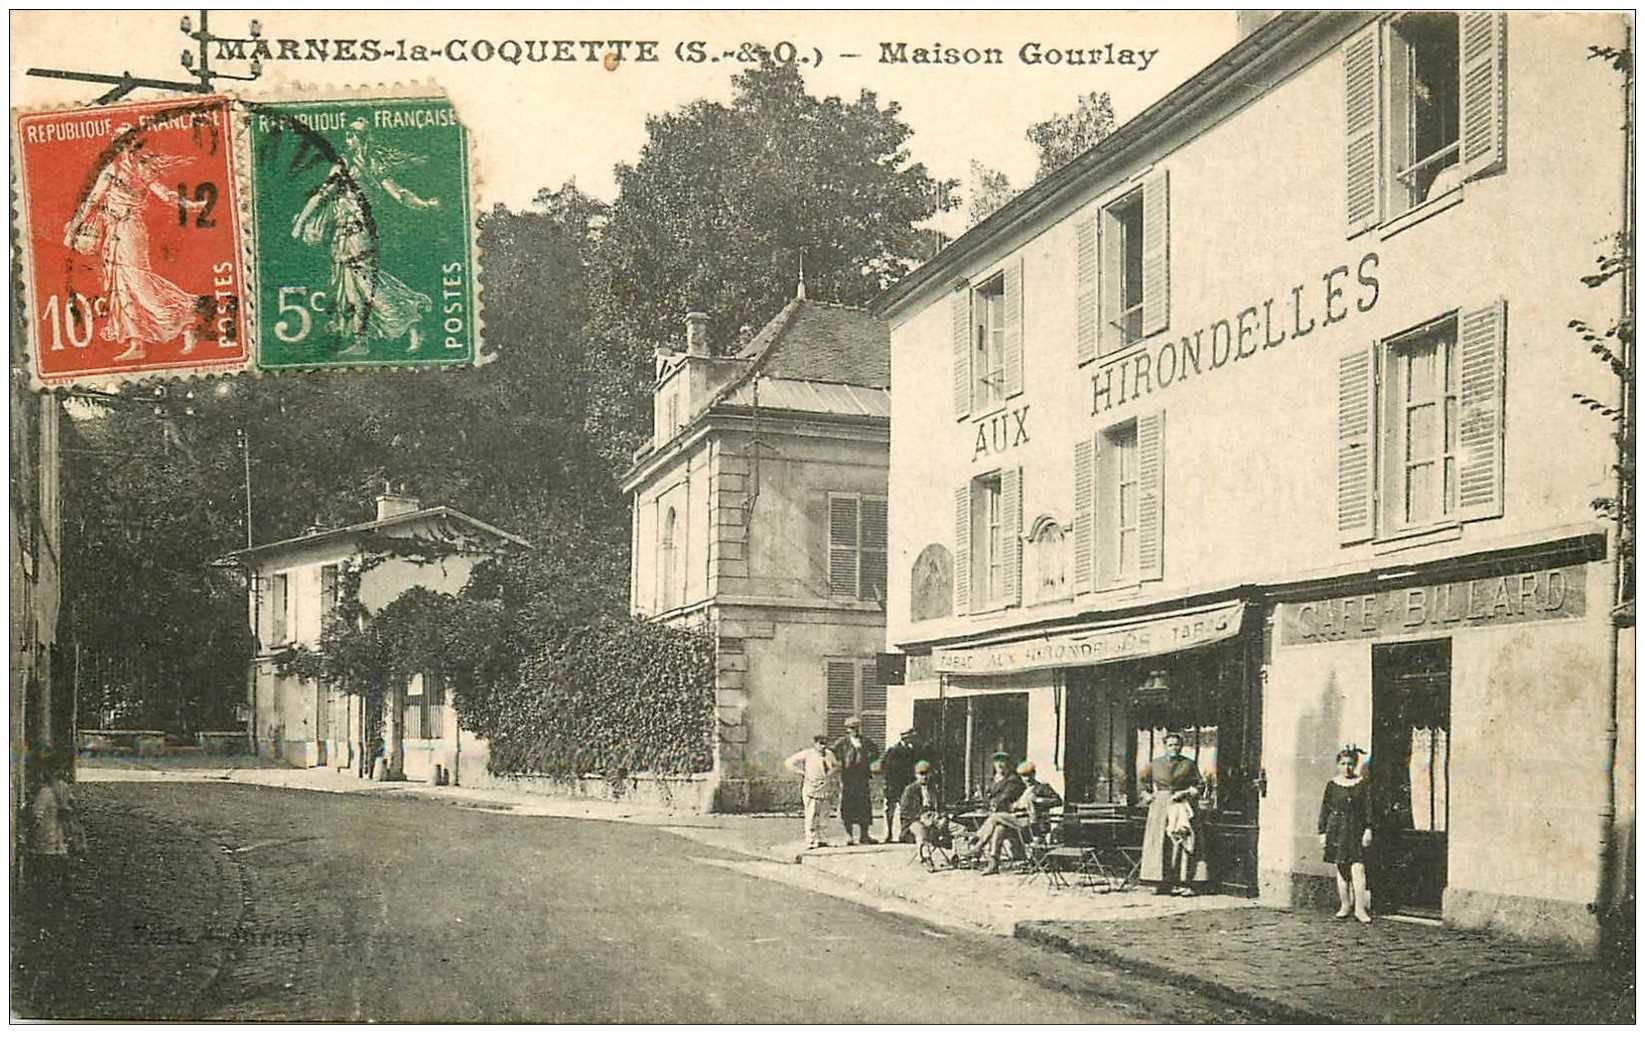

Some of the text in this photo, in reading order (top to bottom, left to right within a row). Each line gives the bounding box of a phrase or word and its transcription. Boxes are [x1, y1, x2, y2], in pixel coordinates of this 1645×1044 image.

[374, 108, 456, 130] FRANÇAISE
[177, 181, 218, 228] 12
[442, 261, 464, 349] POSTES
[972, 251, 1380, 463] AUX HIRONDELLES
